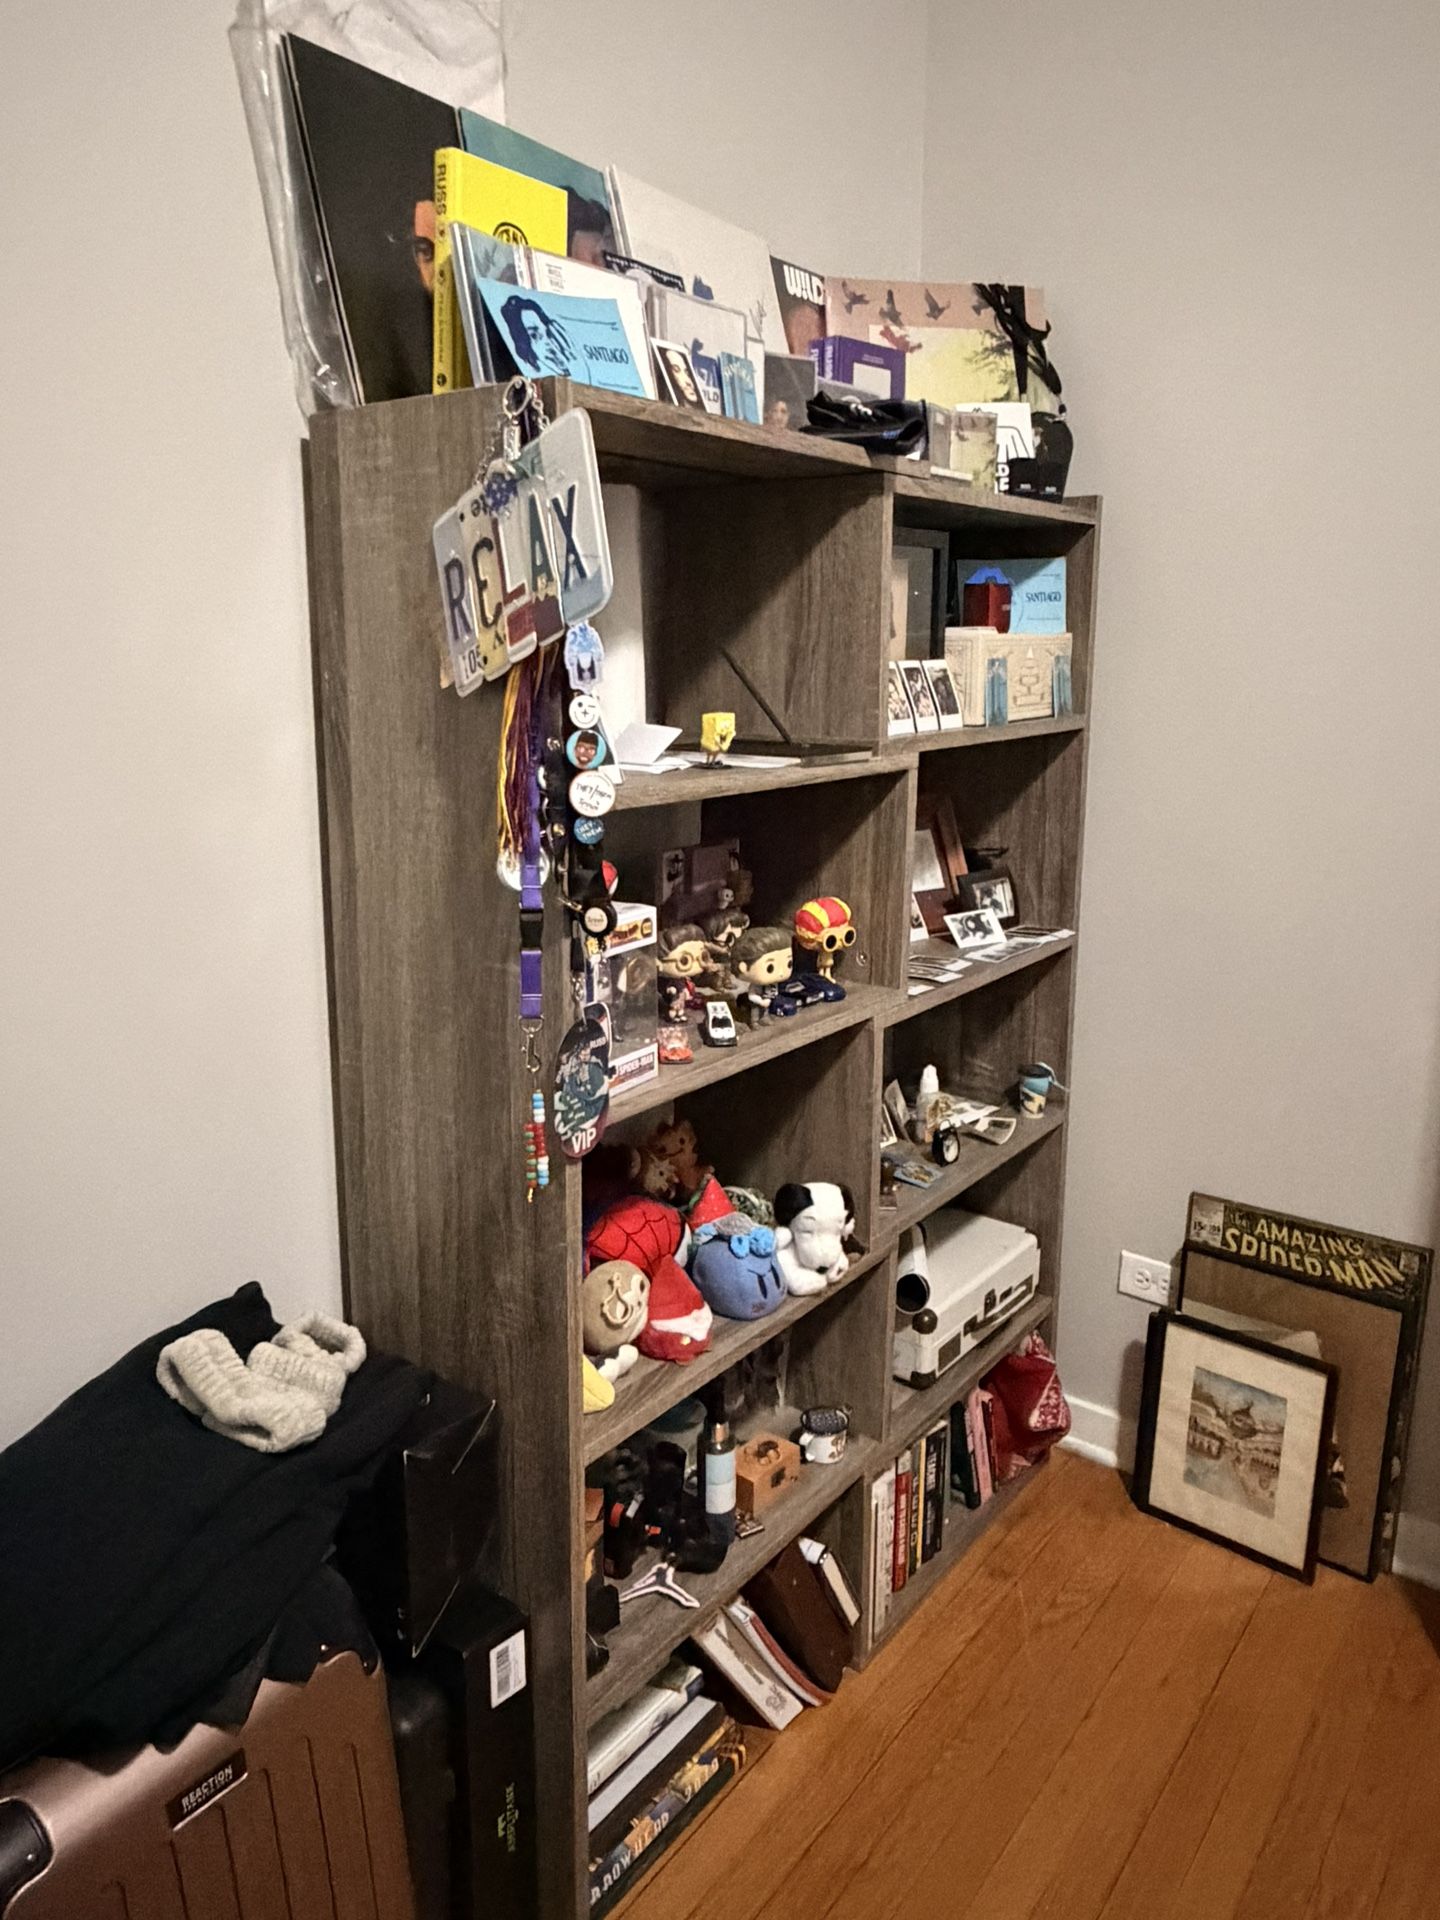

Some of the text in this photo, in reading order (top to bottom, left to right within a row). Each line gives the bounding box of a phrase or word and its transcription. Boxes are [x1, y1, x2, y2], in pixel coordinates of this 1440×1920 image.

[436, 163, 448, 216] RUSS
[584, 344, 629, 365] SANTIAGO
[1025, 590, 1062, 603] SANTIAGO
[571, 1127, 597, 1155] VIP
[1254, 1218, 1365, 1257] AMAZING
[1223, 1227, 1406, 1290] SPIDER-MAN
[182, 1766, 233, 1807] REACTION
